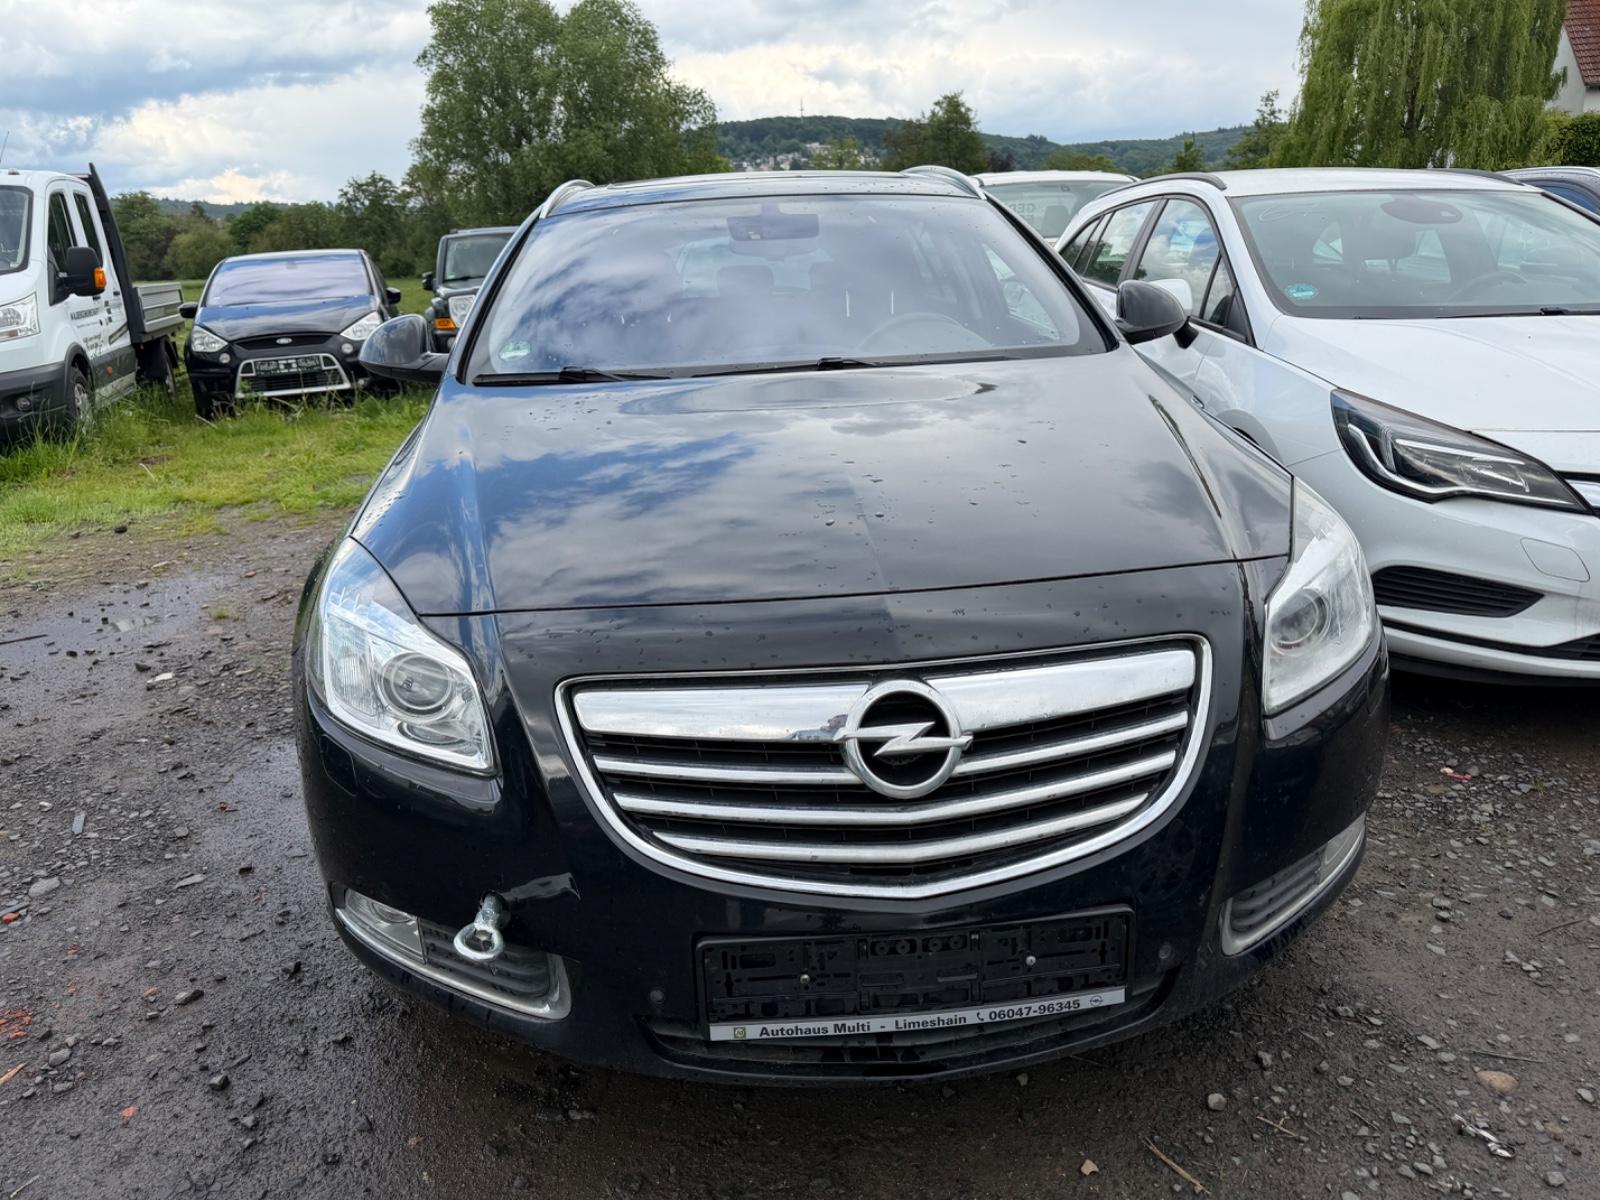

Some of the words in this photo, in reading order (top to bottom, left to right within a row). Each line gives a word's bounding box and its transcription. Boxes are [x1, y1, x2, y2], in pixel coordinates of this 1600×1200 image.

[759, 1025, 829, 1038] Autohaus
[833, 1021, 871, 1034] Multi
[895, 1014, 967, 1030] Limeshain
[988, 999, 1081, 1021] 06047-96345
